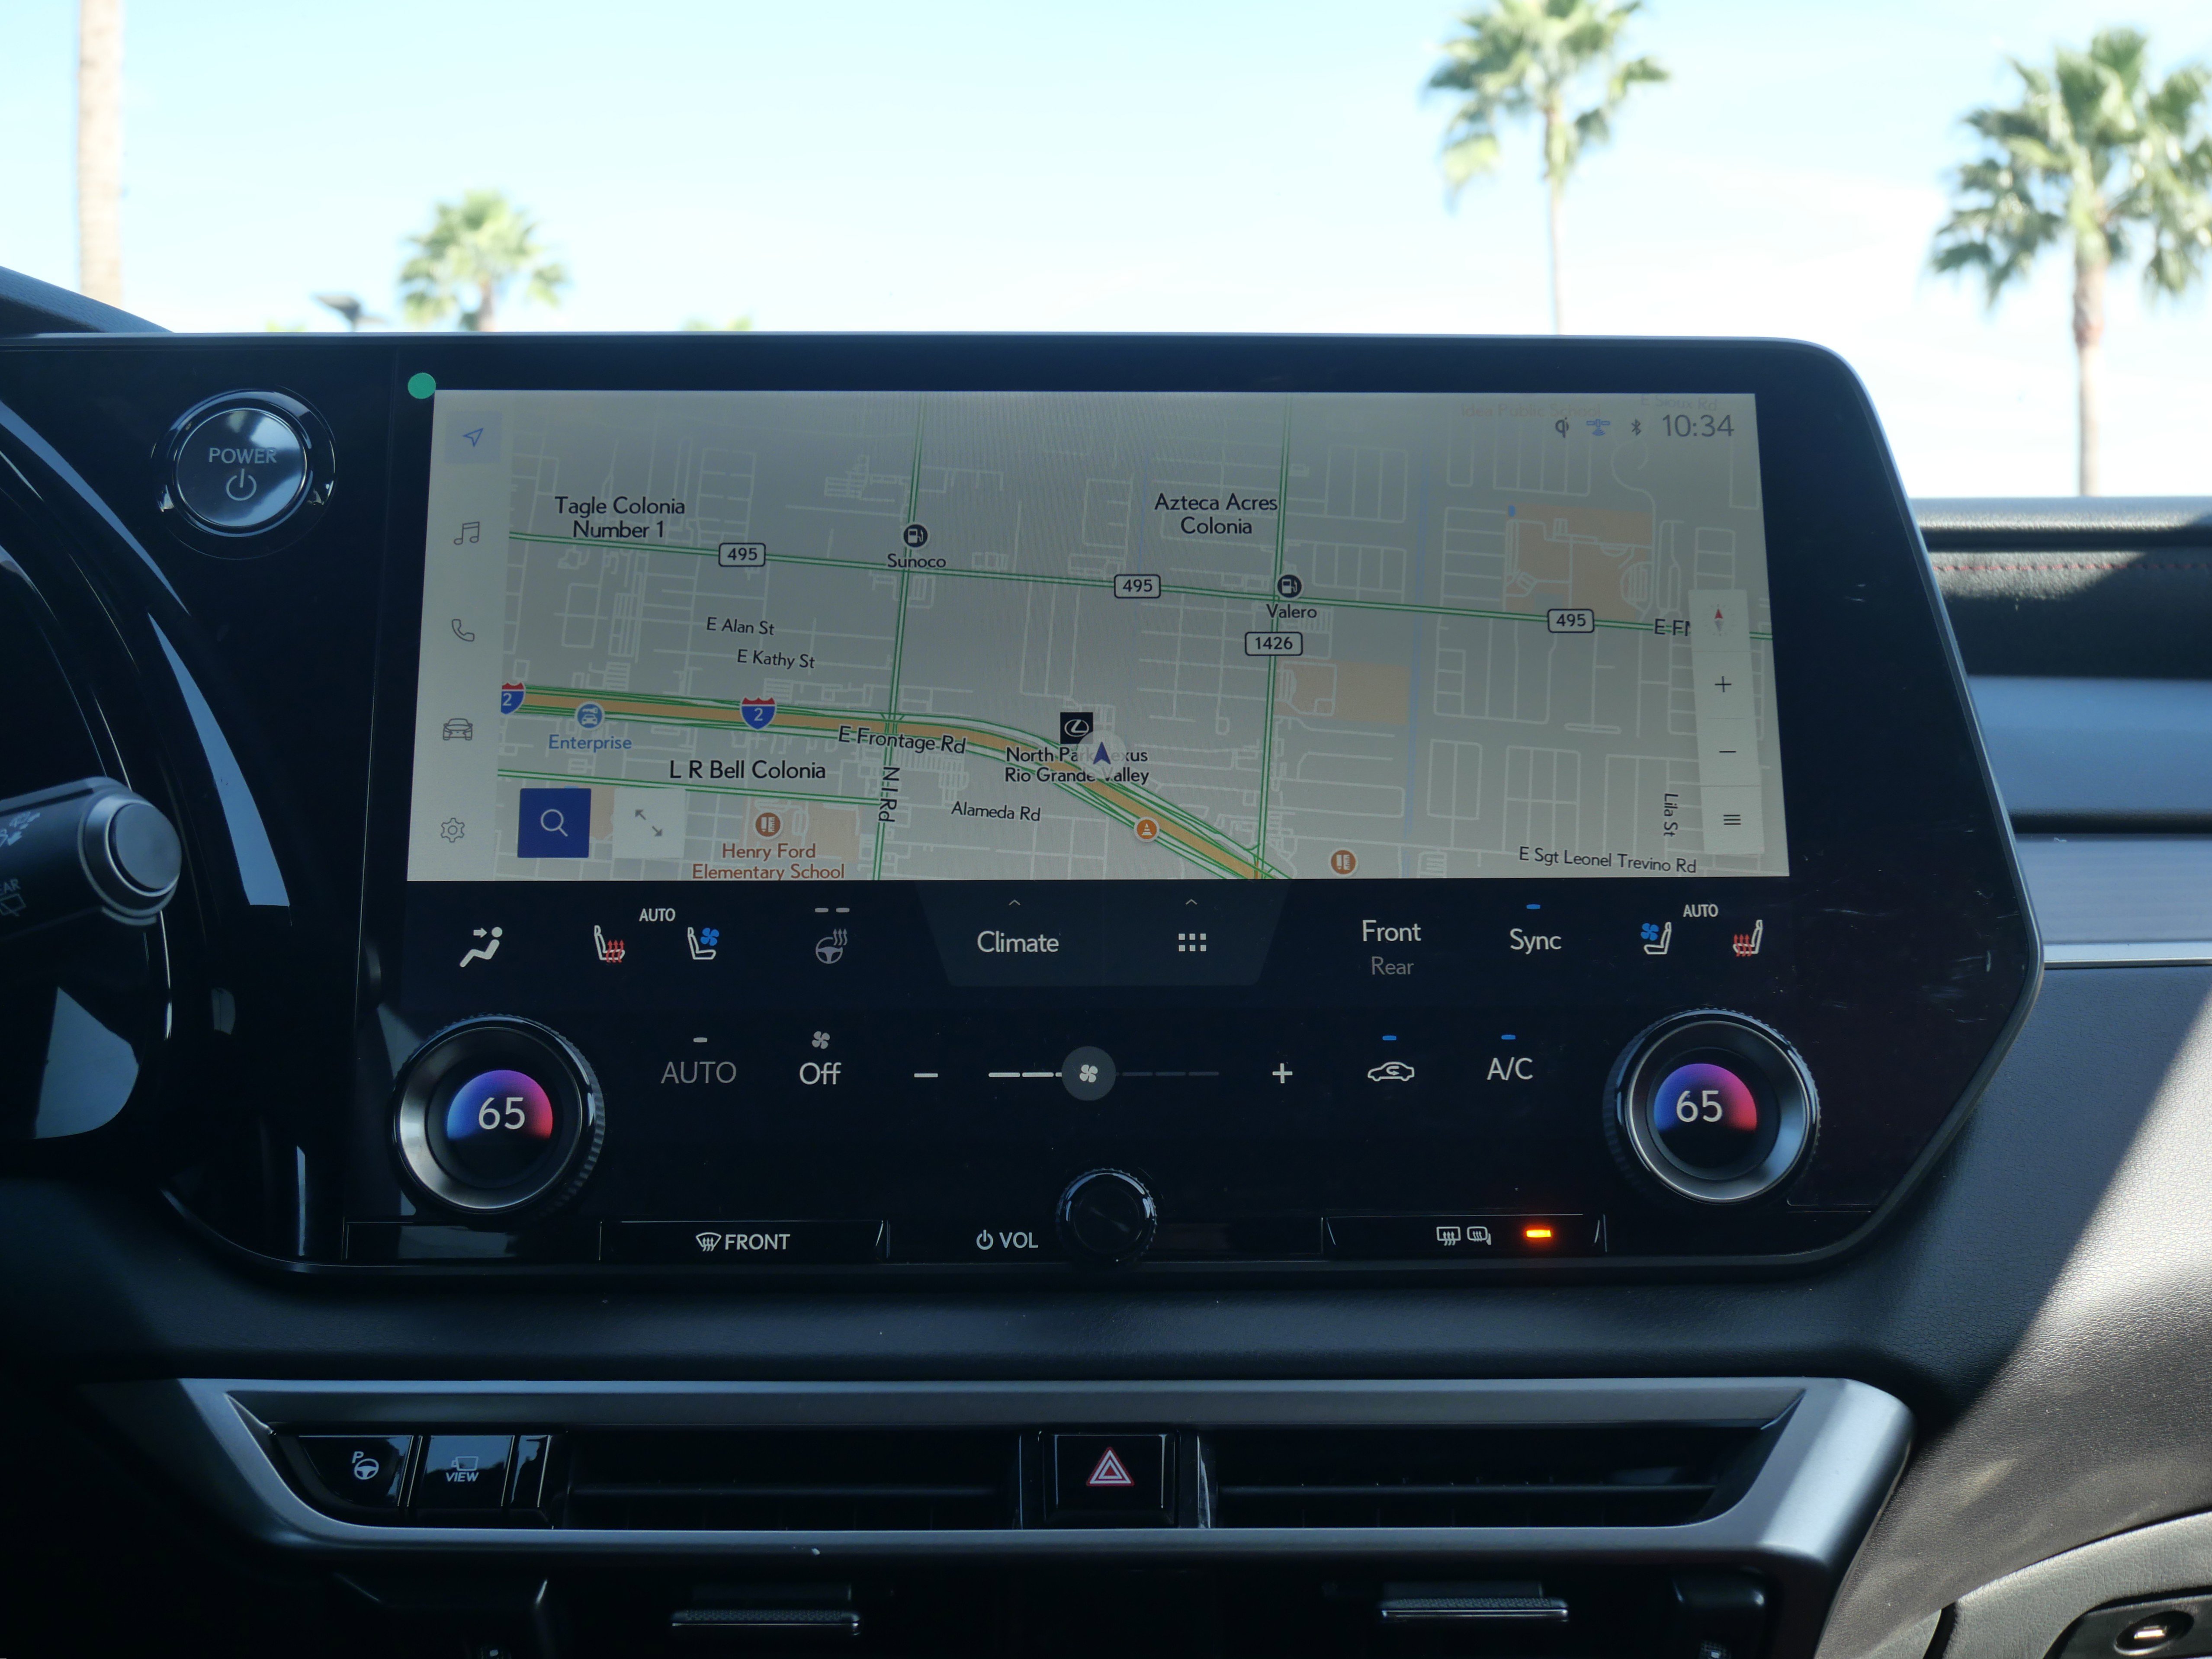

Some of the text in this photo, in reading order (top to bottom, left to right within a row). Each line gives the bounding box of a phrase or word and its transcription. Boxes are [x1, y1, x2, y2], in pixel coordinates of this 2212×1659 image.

[1662, 414, 1734, 437] 10:34
[209, 448, 277, 464] POWER
[555, 496, 685, 517] Tagle Colonia
[1155, 493, 1278, 511] Azteca Acres
[573, 520, 664, 539] Number 1
[1181, 517, 1252, 535] Colonia
[728, 548, 758, 561] 495
[888, 553, 946, 568] Sunoco
[1123, 580, 1153, 593] 495
[1267, 604, 1317, 619] Valero
[1556, 614, 1586, 627] 495
[707, 618, 775, 635] E Alan St
[1655, 619, 1665, 635] E
[1255, 637, 1292, 650] 1426
[737, 650, 815, 670] E Kathy St
[503, 693, 512, 706] 2
[754, 708, 763, 721] 2
[549, 735, 632, 753] Enterprise
[838, 726, 966, 754] E Frontage Rd
[1007, 747, 1053, 761] North
[670, 761, 826, 779] L R Bell Colonia
[883, 767, 899, 781] N
[1005, 767, 1031, 782] Rio
[1037, 767, 1095, 782] Grande
[879, 798, 897, 822] Rd
[951, 801, 1040, 821] Alameda Rd
[1664, 793, 1678, 837] Lila St
[722, 843, 815, 862] Henry Ford
[1520, 847, 1696, 873] E Sgt Leonel Trevino Rd
[693, 864, 844, 880] Elementary School
[639, 908, 676, 922] AUTO
[1683, 904, 1718, 918] AUTO
[1362, 919, 1421, 942] Front
[977, 931, 1059, 953] Climate
[1510, 929, 1562, 955] Sync
[1371, 956, 1414, 976] Rear
[661, 1061, 736, 1084] AUTO
[799, 1062, 841, 1085] Off
[1487, 1057, 1534, 1081] A/C
[478, 1097, 525, 1130] 65
[1676, 1090, 1723, 1123] 65
[725, 1234, 790, 1250] FRONT
[999, 1232, 1038, 1248] VOL
[352, 1451, 364, 1464] P
[446, 1472, 478, 1482] VIEW
